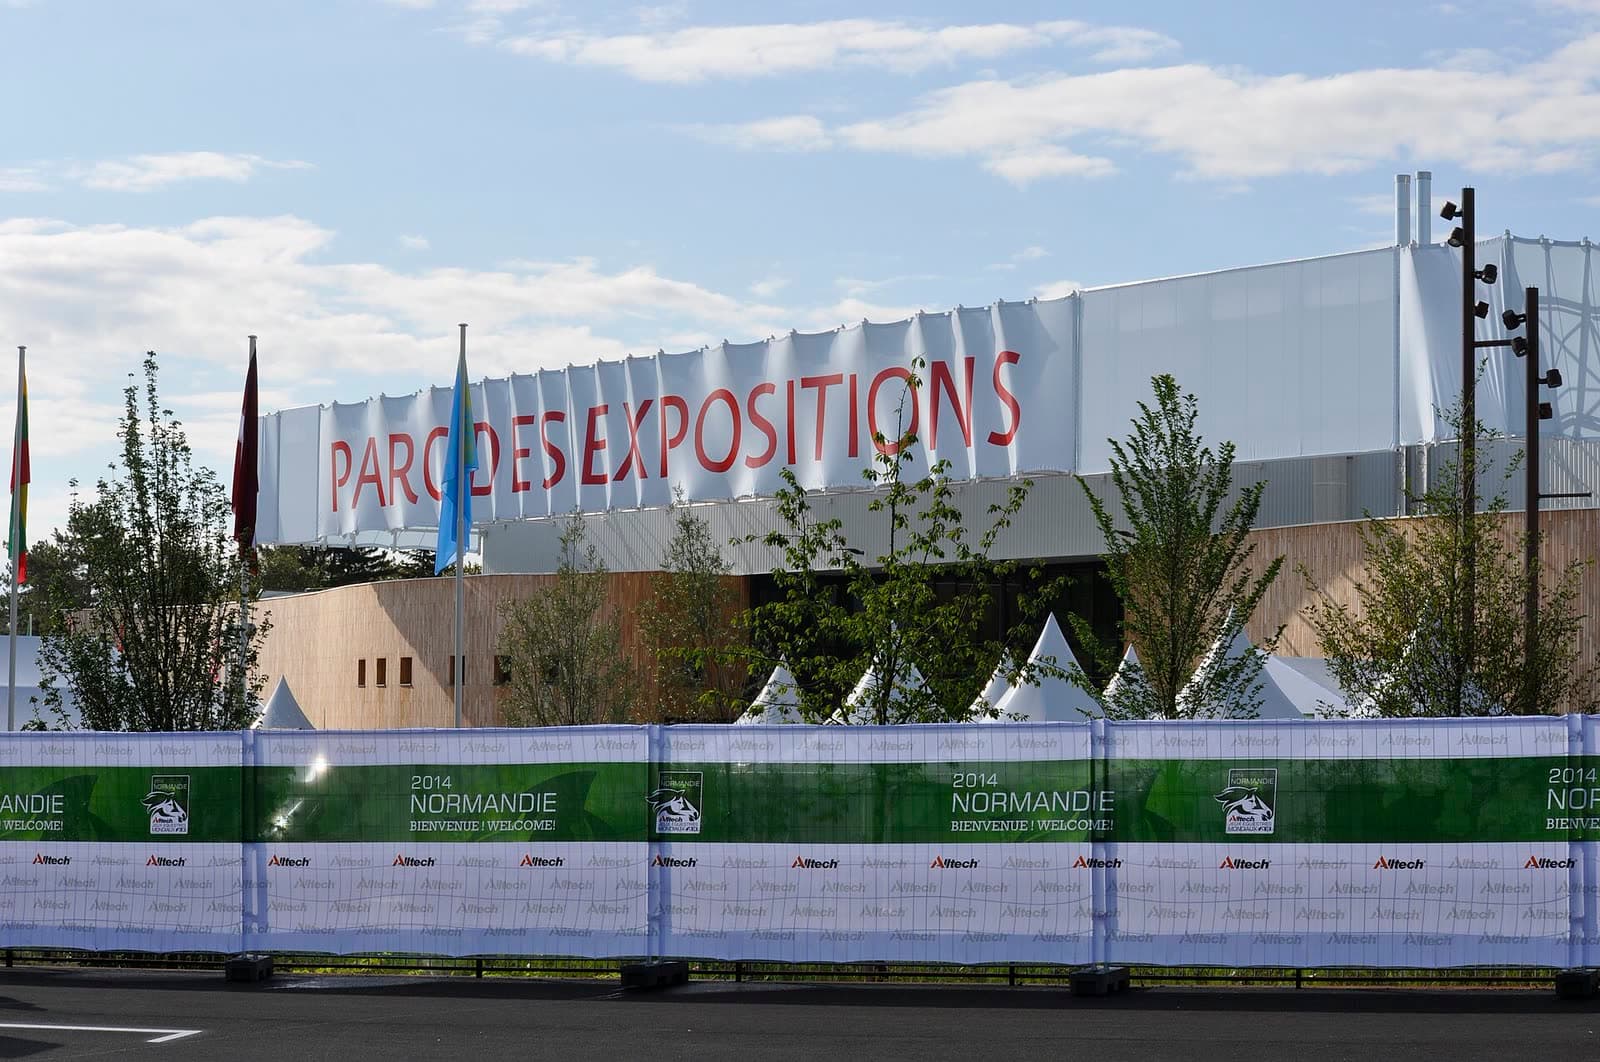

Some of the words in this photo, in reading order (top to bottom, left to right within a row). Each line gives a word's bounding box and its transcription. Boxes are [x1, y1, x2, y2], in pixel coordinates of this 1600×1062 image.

[331, 426, 449, 512] PARC
[470, 411, 567, 496] DES
[581, 351, 1021, 486] EXPOSITIONS
[953, 773, 997, 787] 2014
[1232, 777, 1274, 785] NORMANDIE
[1549, 768, 1597, 783] 2014
[412, 776, 451, 789] 2014
[410, 793, 556, 814] NORMANDIE
[952, 791, 1114, 812] NORMANDIE
[4, 820, 63, 831] WELCOME!
[409, 820, 479, 831] BIENVENUE
[487, 820, 556, 831] WELCOME!
[951, 821, 1027, 831] BIENVENUE
[1037, 820, 1113, 831] WELCOME!
[33, 853, 72, 865] Alltech
[146, 853, 187, 866] Alltech
[268, 854, 311, 866] Alltech
[393, 854, 436, 866] Alltech
[520, 854, 565, 866] Alltech
[652, 855, 697, 867] Alltech
[792, 855, 839, 868] Alltech
[930, 855, 980, 869] Alltech
[1073, 855, 1124, 868] Alltech
[1220, 856, 1271, 869] Alltech
[1374, 856, 1425, 869] Alltech
[1524, 856, 1577, 869] Alltech
